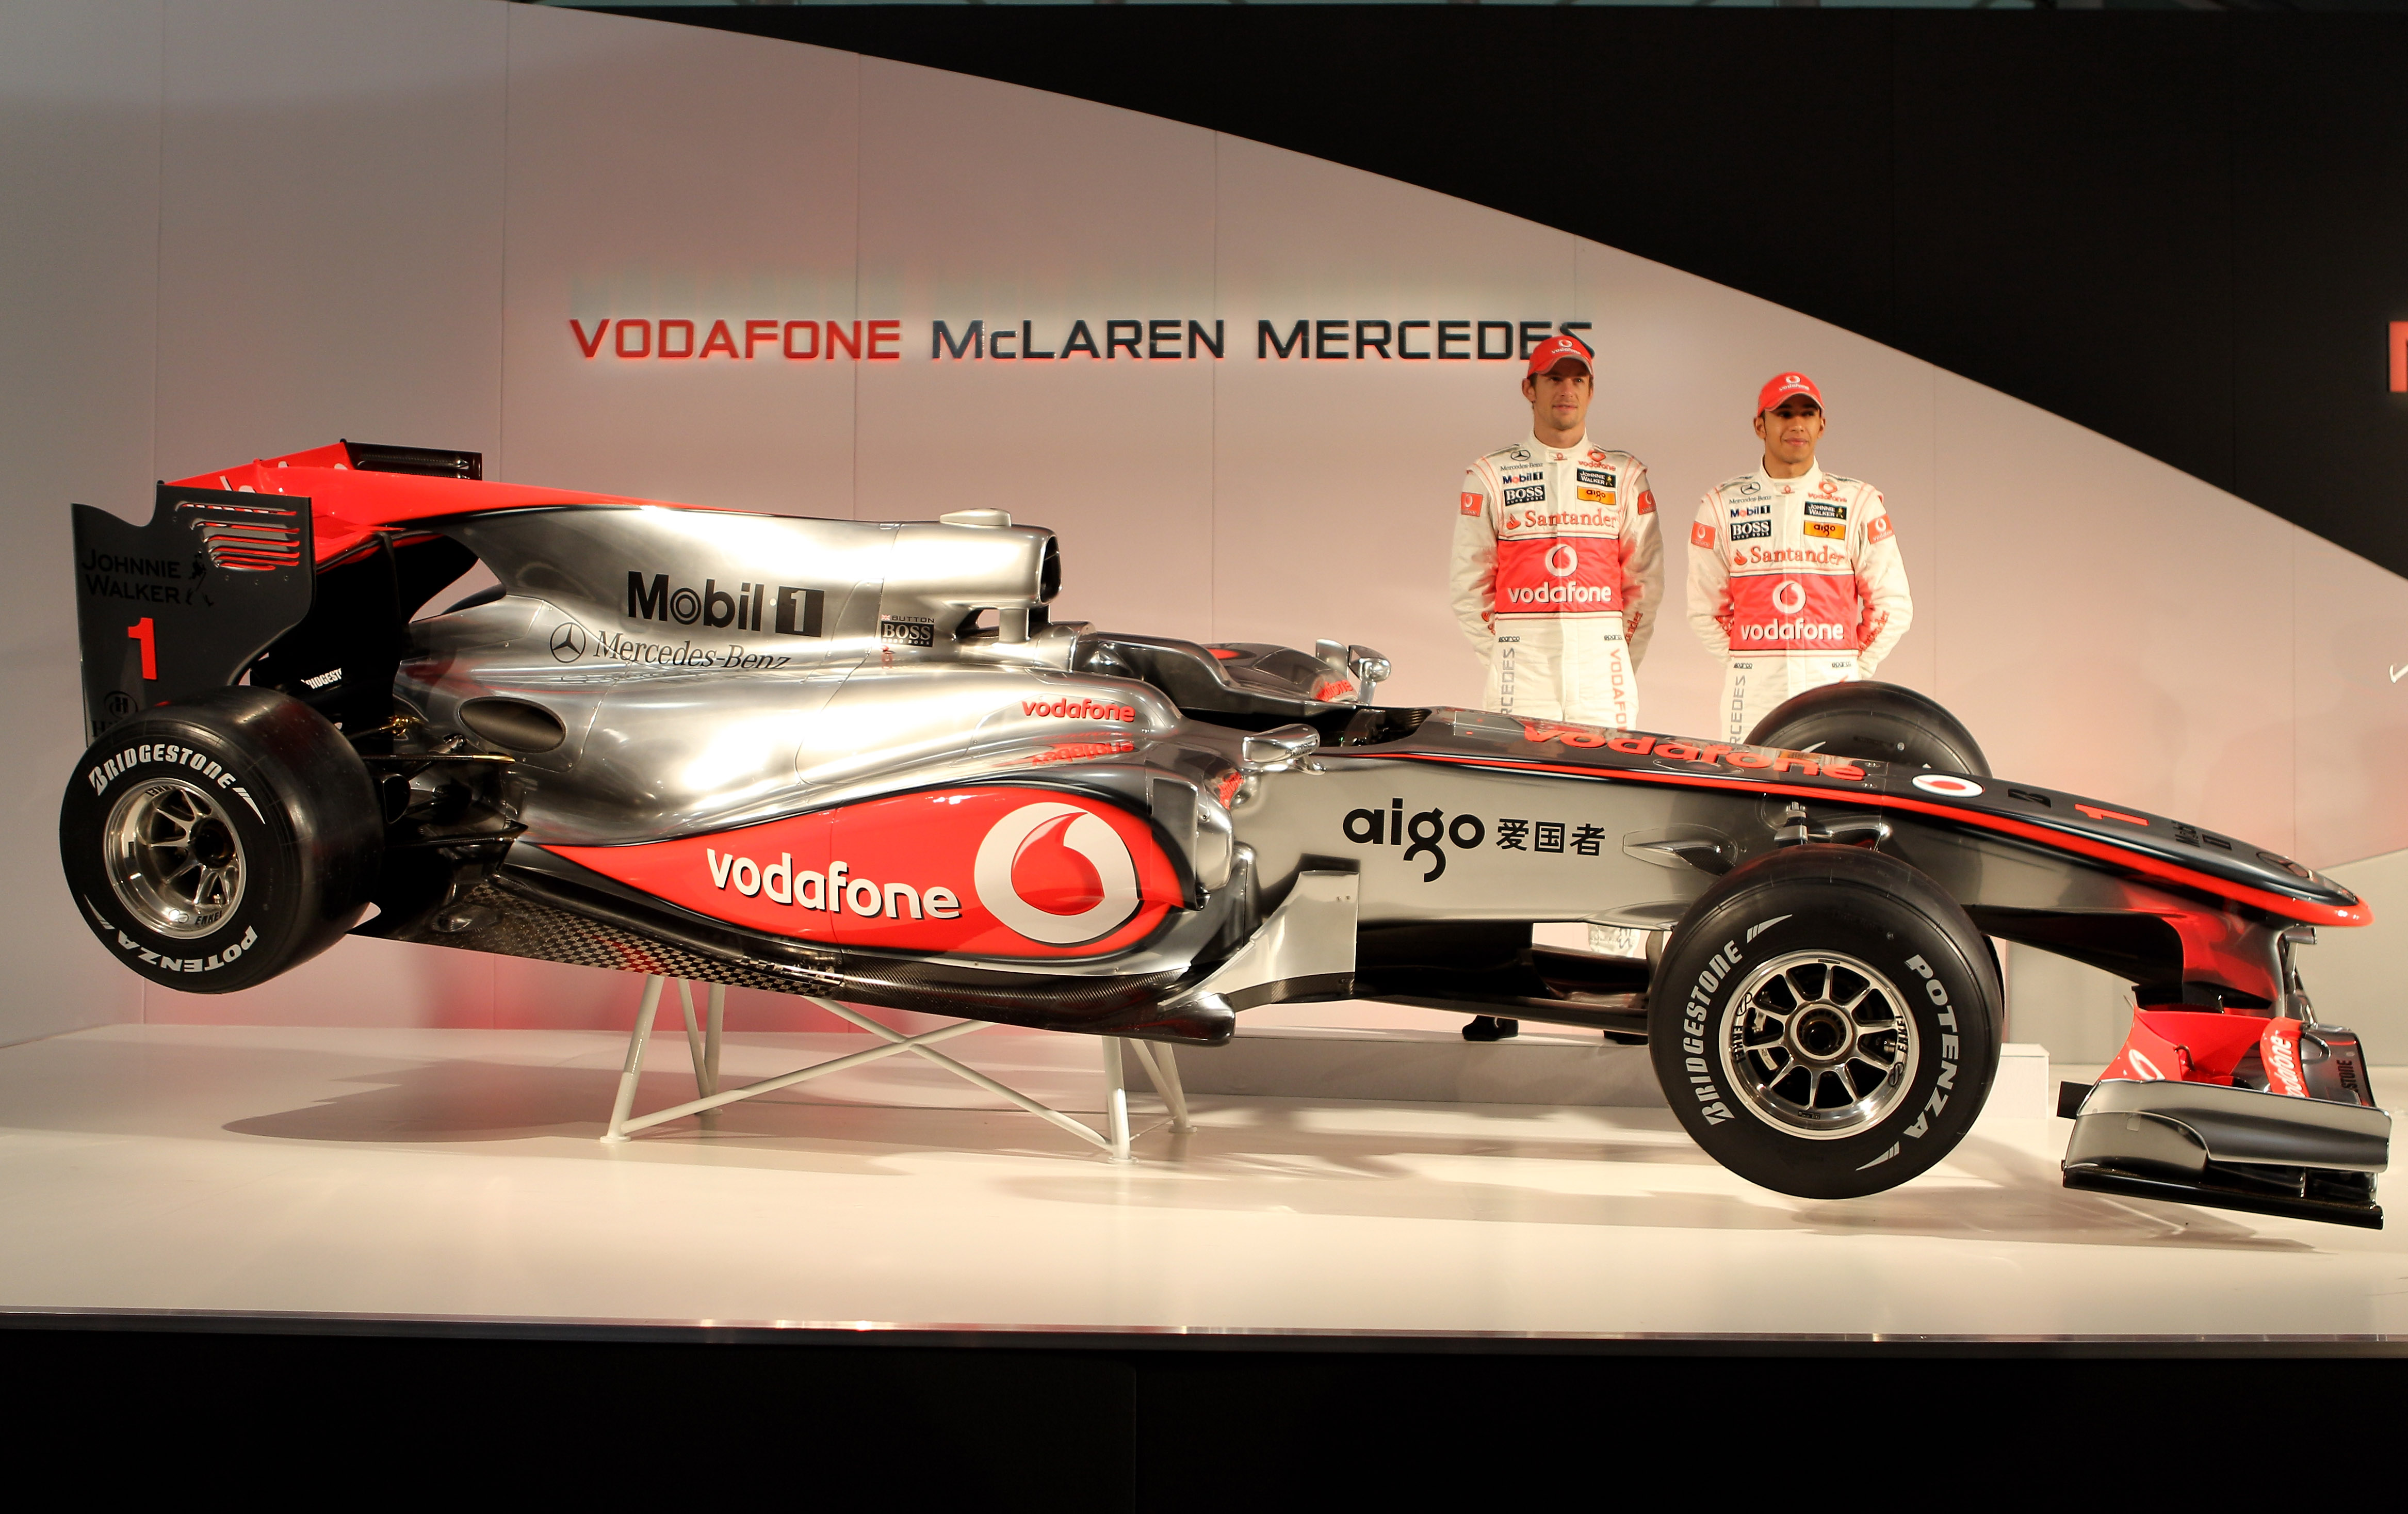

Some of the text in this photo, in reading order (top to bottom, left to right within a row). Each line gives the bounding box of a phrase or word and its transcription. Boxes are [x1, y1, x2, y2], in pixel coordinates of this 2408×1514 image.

[570, 318, 901, 360] VODAFONE
[932, 319, 1225, 360] McLAREN
[1578, 460, 1616, 471] vodafone
[1580, 471, 1605, 480] JOHNNIE
[1502, 472, 1532, 485] Mobil
[1581, 475, 1605, 485] WALKER
[1506, 486, 1543, 501] BOSS
[1586, 489, 1606, 501] aigo
[1808, 492, 1847, 503] vodafone
[1525, 509, 1618, 528] Santander
[1730, 506, 1760, 518] Mobil
[1808, 504, 1835, 512] JOHNNIE
[1809, 508, 1835, 517] WALKER
[1732, 521, 1770, 536] BOSS
[1814, 523, 1836, 537] aigo
[82, 549, 181, 578] JOHNNIE
[1750, 545, 1845, 566] Santander
[86, 573, 181, 604] WALKER
[1508, 582, 1612, 604] vodafone
[627, 571, 765, 632] Mobil
[892, 615, 935, 623] BUTTON
[1742, 619, 1844, 641] vodafone
[883, 623, 931, 640] BOSS
[127, 617, 157, 680] 1
[593, 631, 791, 670] Mercedes-Benz
[1501, 647, 1515, 714] RCEDES
[1610, 648, 1627, 730] VODAFO
[1021, 698, 1135, 722] vodafone
[1729, 675, 1746, 744] RCEDES
[1524, 725, 1869, 782] vodafone
[88, 743, 237, 796] BRIDGESTONE
[1342, 797, 1486, 883] aigo
[1495, 817, 1605, 857] 爱国者
[706, 847, 962, 920] vodafone
[118, 925, 258, 973] POTENZA
[1683, 940, 1743, 1125] BRIDGESTONE
[1903, 954, 1959, 1139] POTENZA
